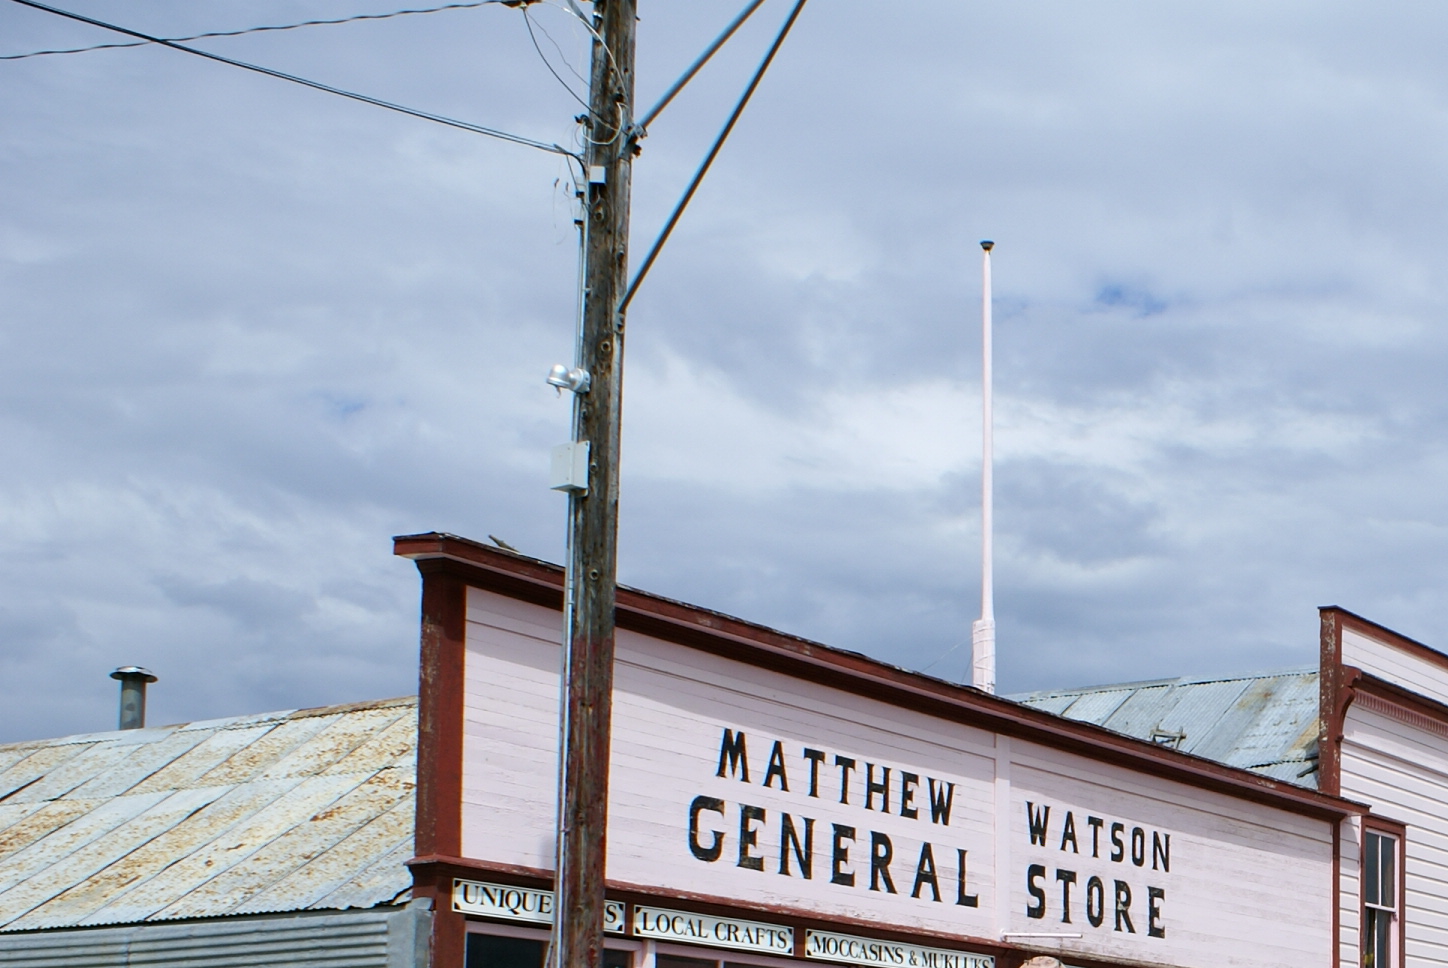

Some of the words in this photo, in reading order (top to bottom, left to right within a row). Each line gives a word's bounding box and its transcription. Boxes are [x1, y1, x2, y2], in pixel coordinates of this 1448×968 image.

[715, 727, 955, 826] MATTHEW
[1025, 801, 1171, 873] WATSON
[688, 795, 979, 908] GENERAL
[1026, 863, 1166, 939] STORE
[462, 883, 553, 915] UNIQUE
[642, 911, 709, 939] LOCAL
[714, 921, 788, 949] CRAFTS
[813, 935, 904, 965] MOCCASINS
[908, 951, 919, 967] &
